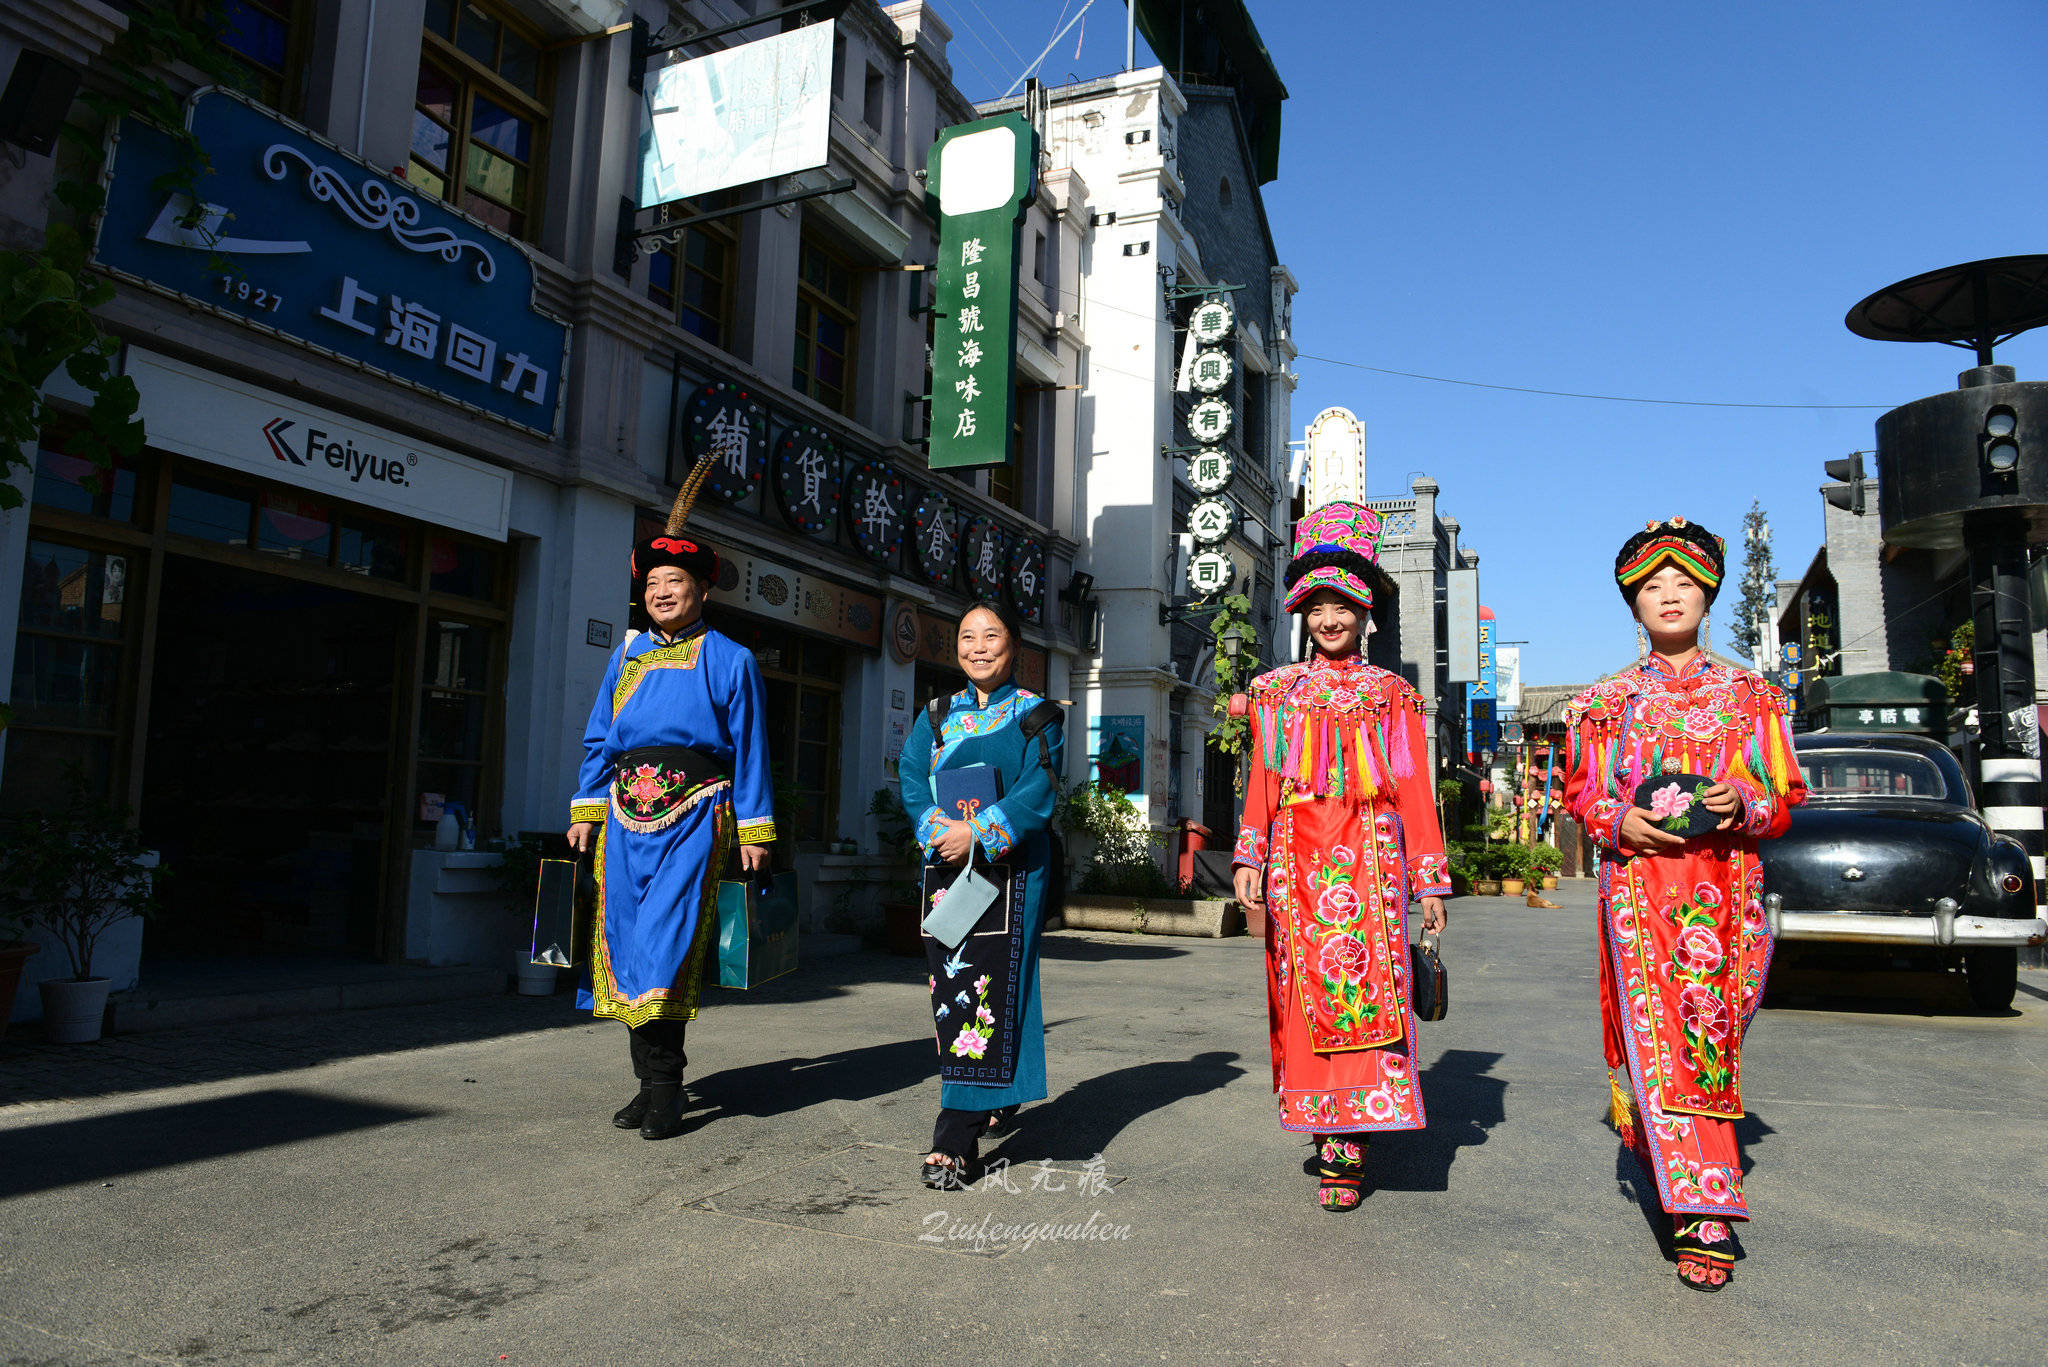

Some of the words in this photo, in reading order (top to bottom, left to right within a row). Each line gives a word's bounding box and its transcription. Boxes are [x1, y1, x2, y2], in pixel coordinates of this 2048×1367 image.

[222, 275, 282, 312] 1927
[319, 275, 549, 405] 上海回力
[953, 237, 987, 439] 隆昌號海味店
[1198, 311, 1222, 583] 華興有限公司
